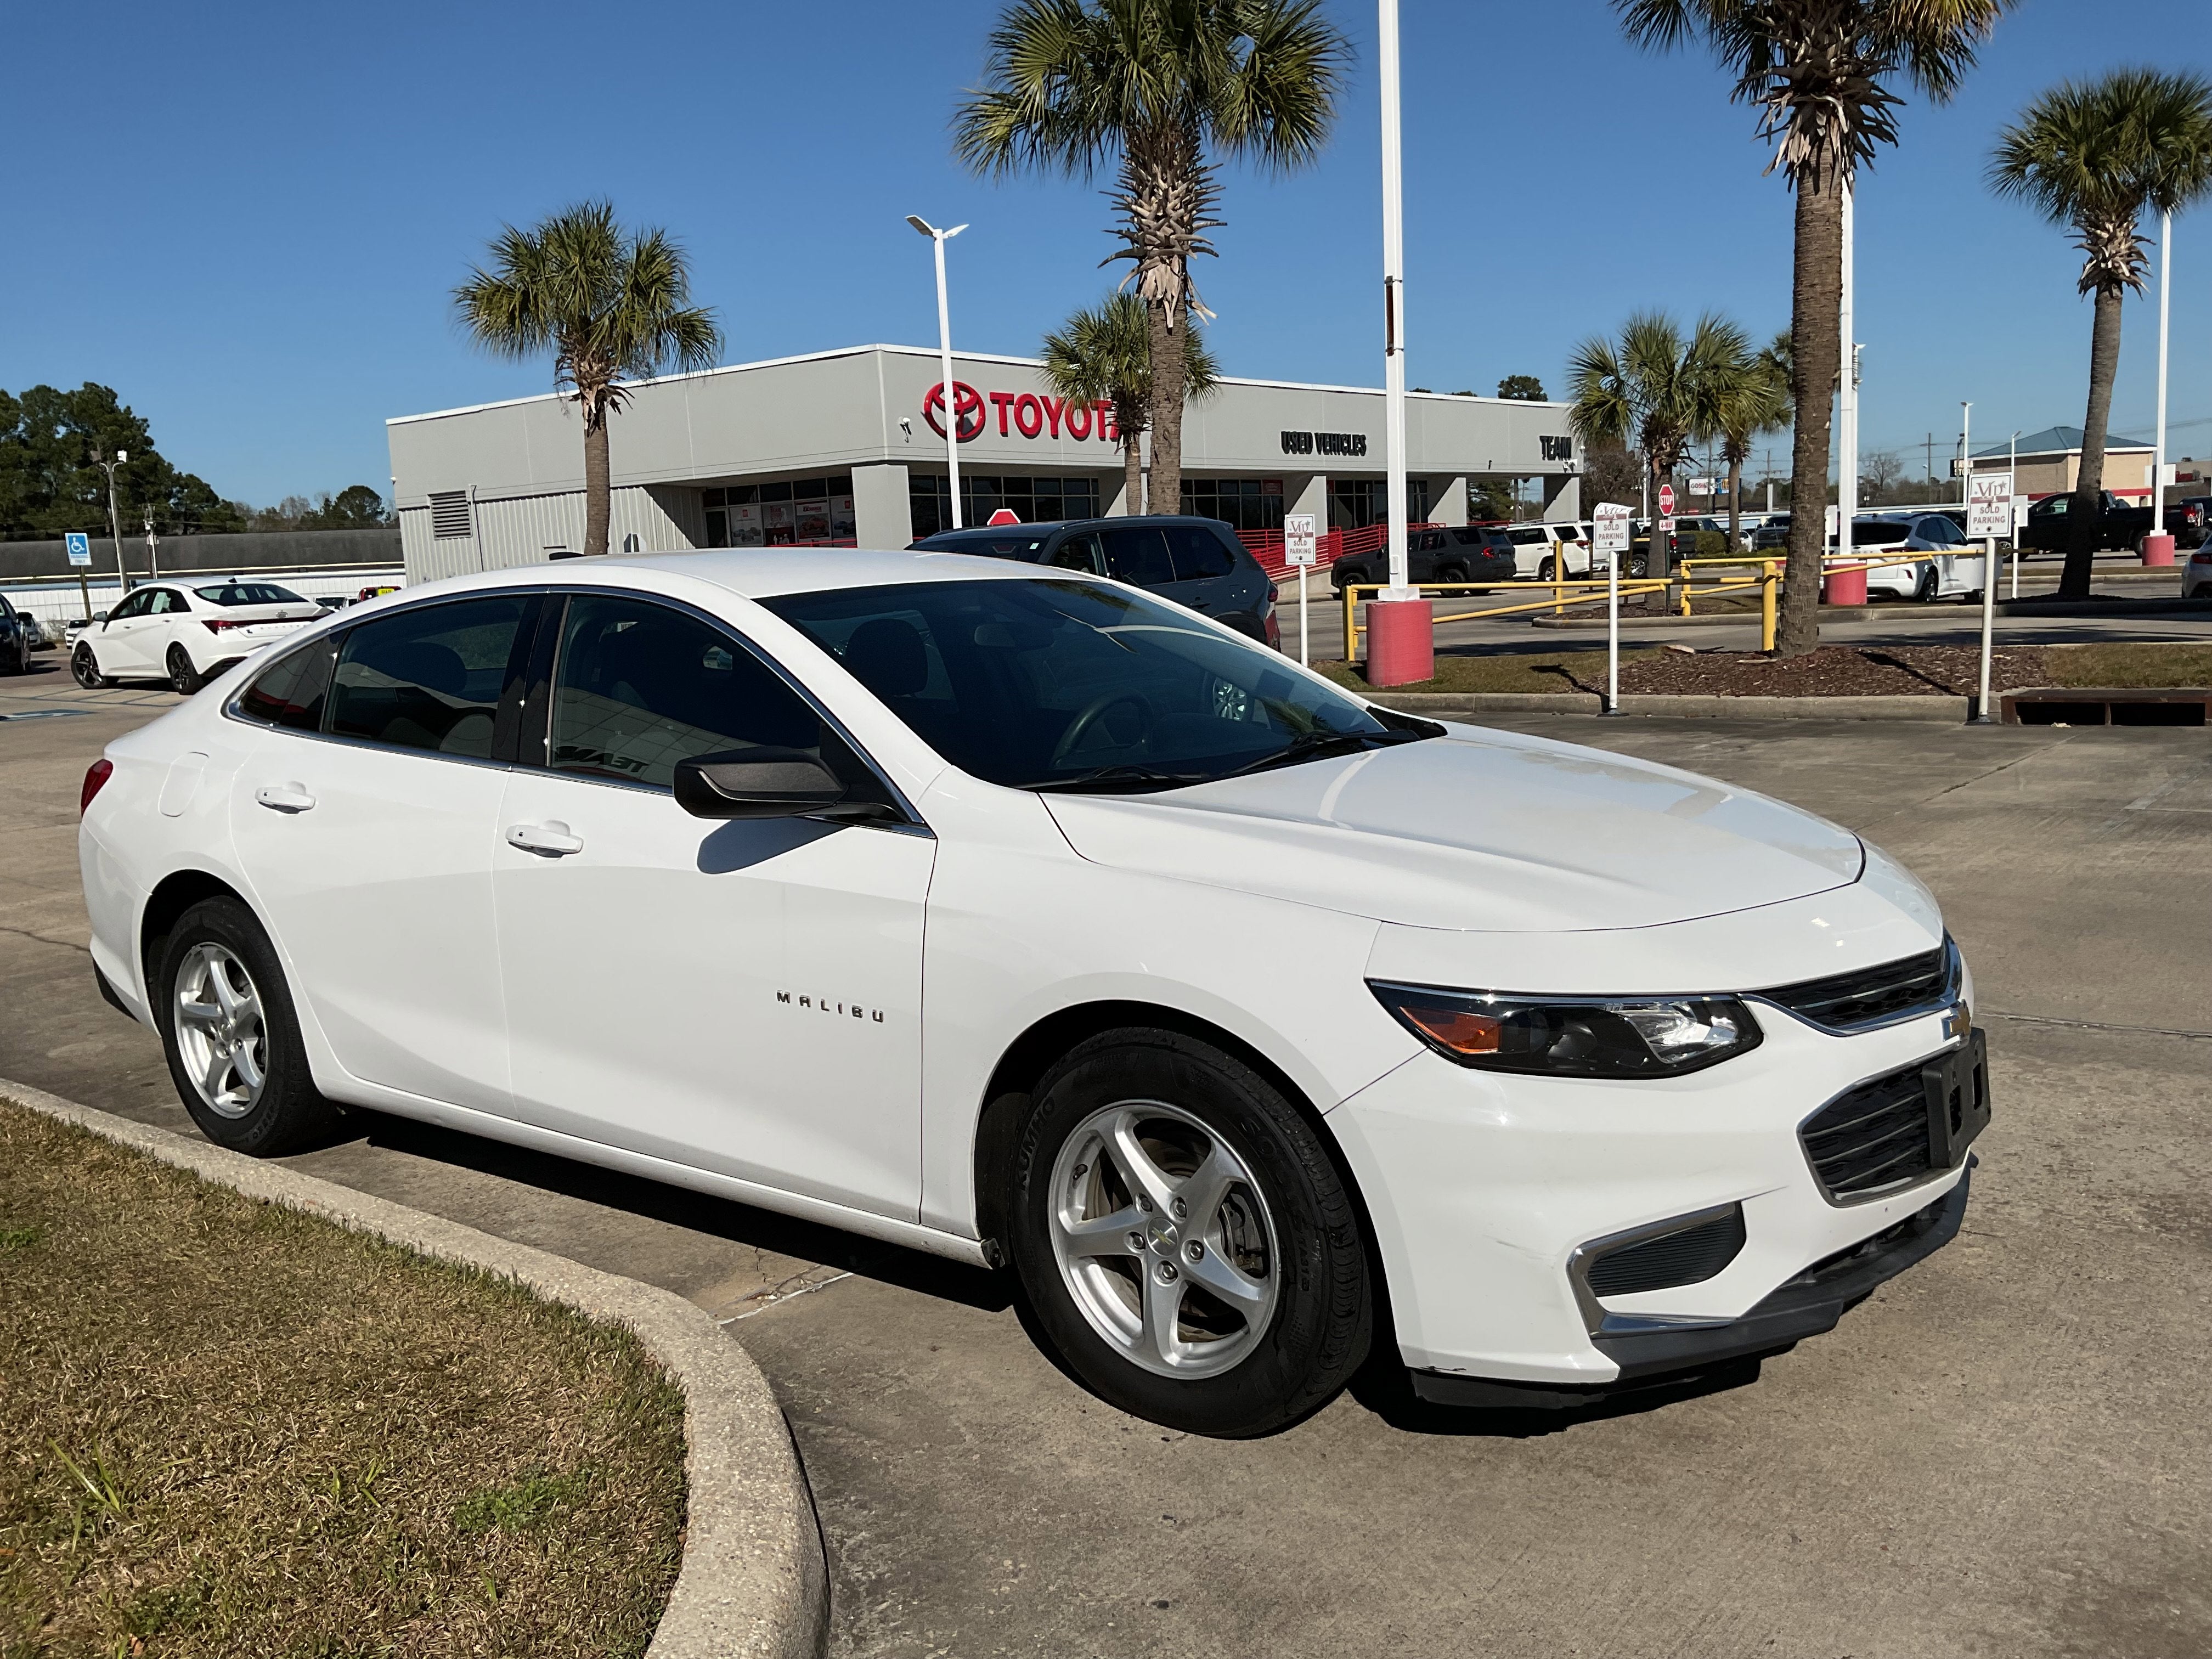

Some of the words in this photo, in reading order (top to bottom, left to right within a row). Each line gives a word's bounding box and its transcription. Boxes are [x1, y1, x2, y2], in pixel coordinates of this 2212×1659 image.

[990, 392, 1119, 442] TOYOT
[1281, 431, 1313, 454] USED
[1314, 432, 1367, 456] VEHICLES
[1539, 436, 1572, 461] TEAM
[1660, 495, 1673, 505] STOP
[1973, 516, 2005, 524] PARKING
[777, 990, 884, 1023] MALIBU
